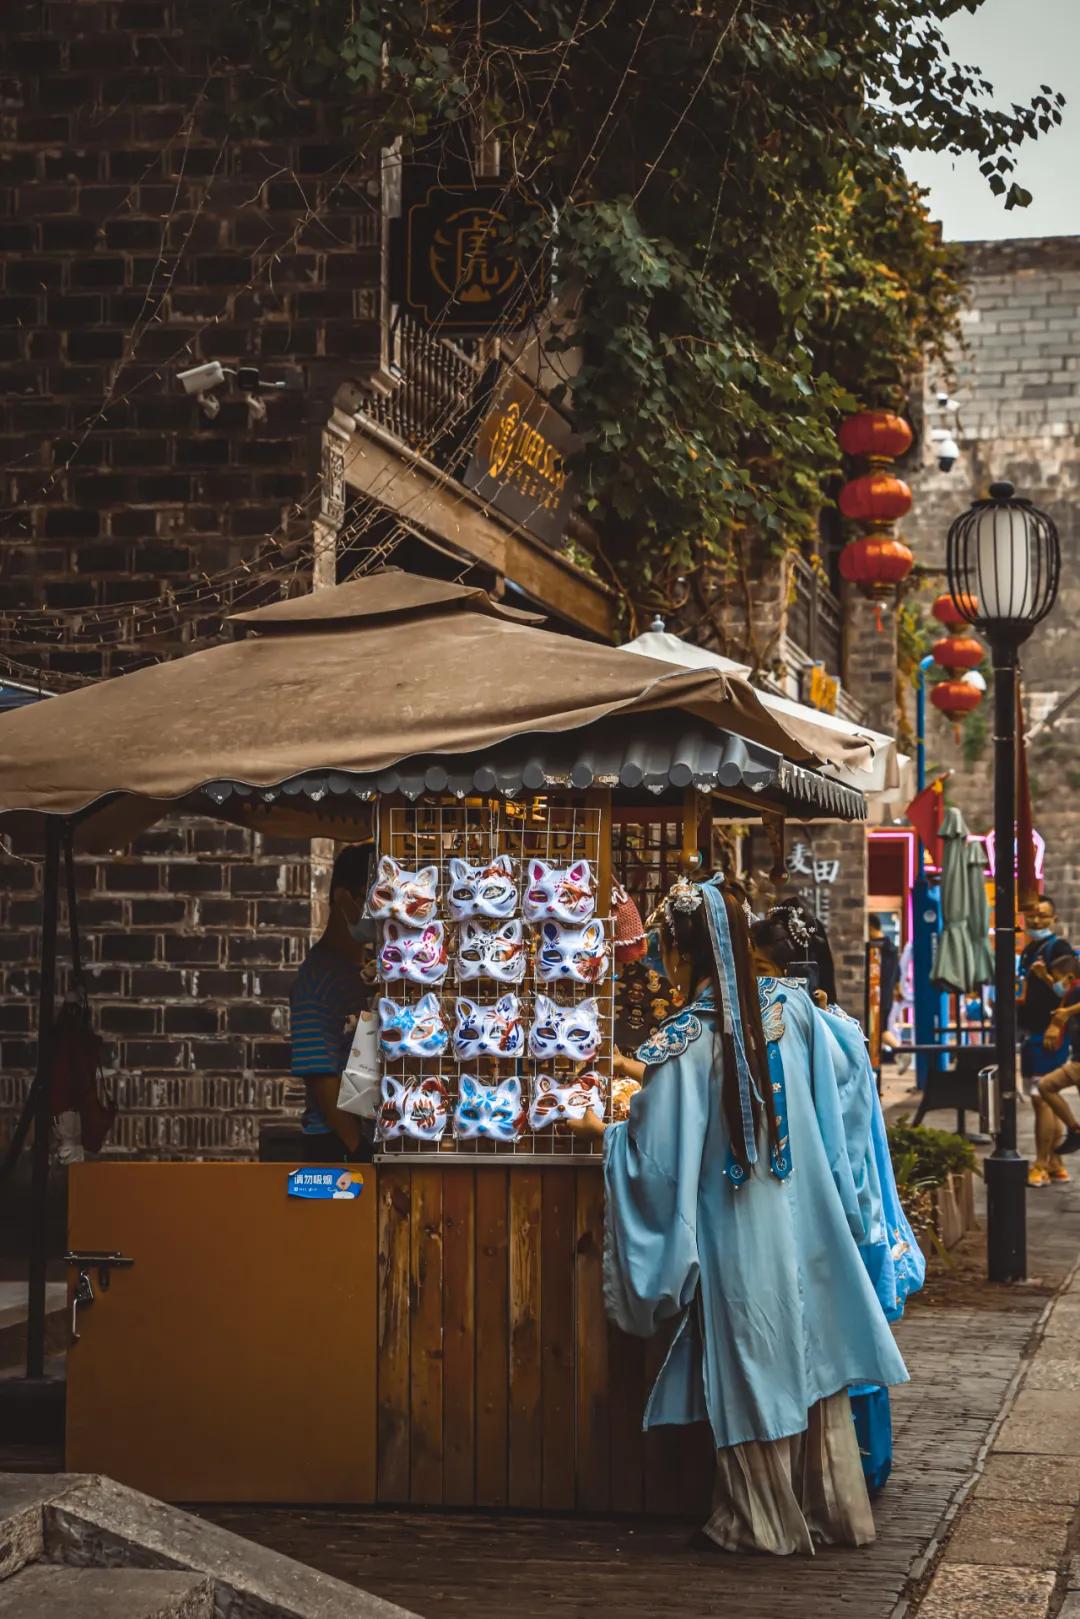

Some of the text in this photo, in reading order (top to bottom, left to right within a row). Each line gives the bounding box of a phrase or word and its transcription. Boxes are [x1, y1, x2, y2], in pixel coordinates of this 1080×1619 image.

[455, 215, 499, 292] 虎
[786, 842, 839, 884] 麦田
[294, 1174, 333, 1185] 请勿吸烟
